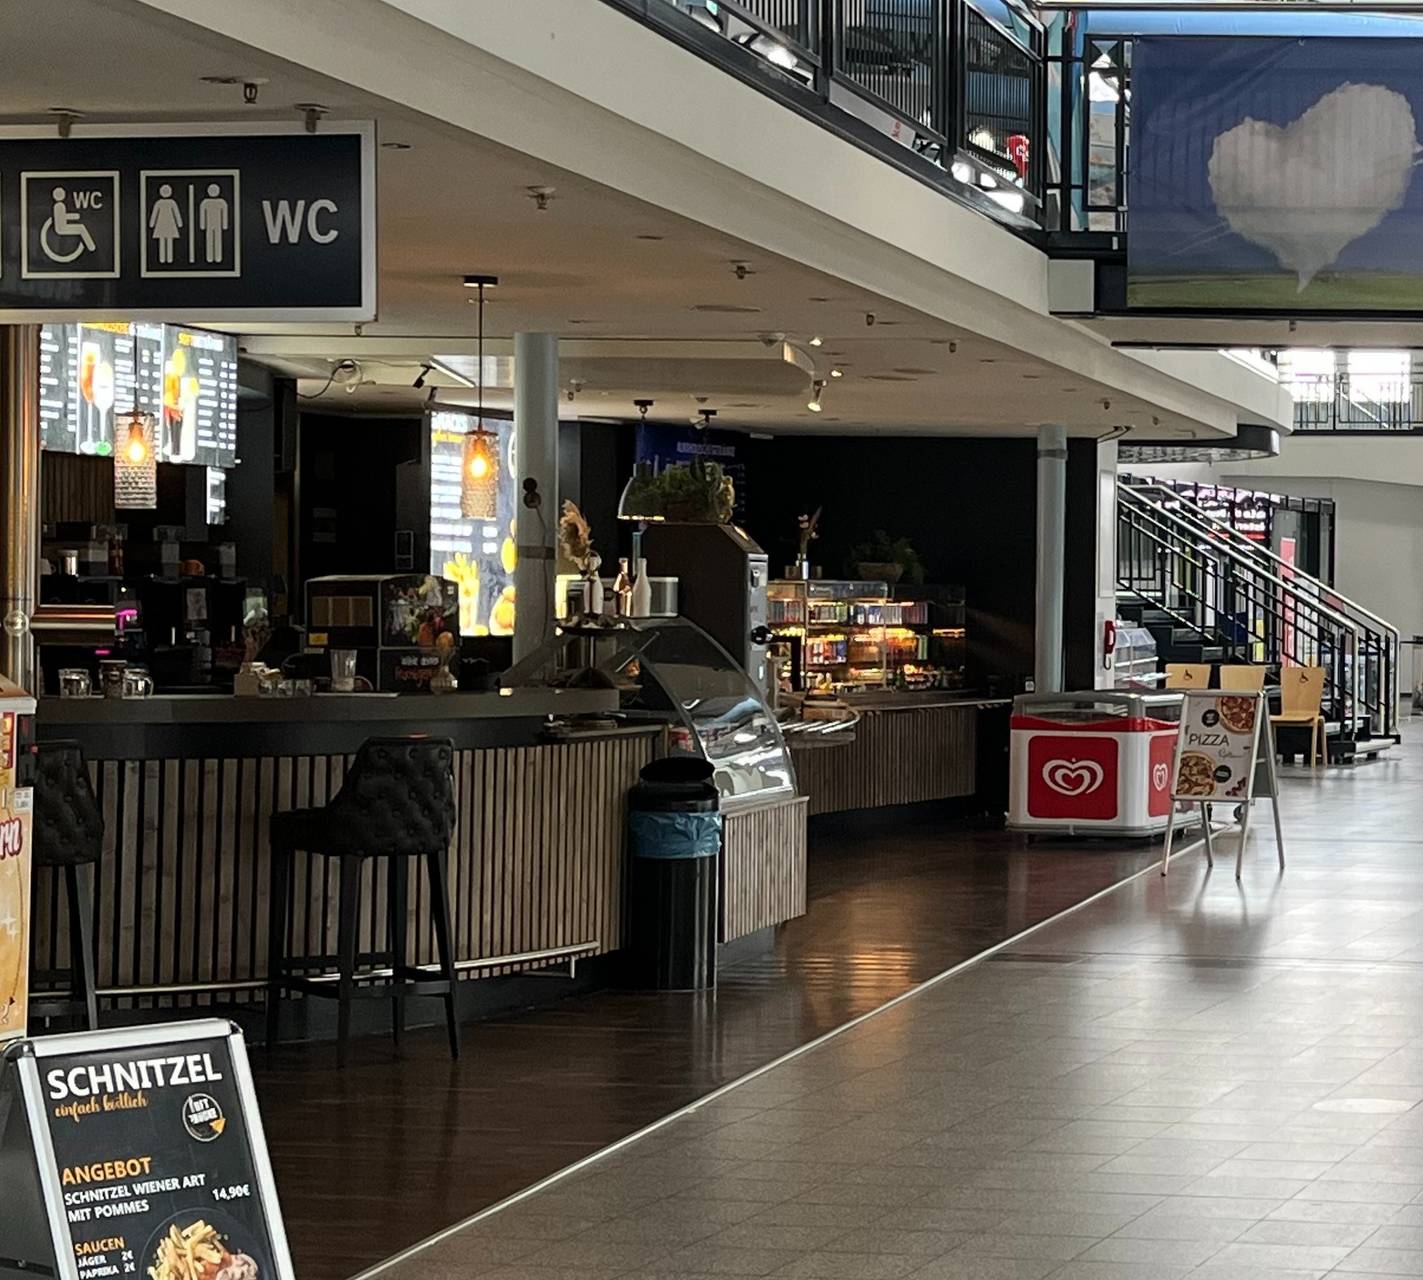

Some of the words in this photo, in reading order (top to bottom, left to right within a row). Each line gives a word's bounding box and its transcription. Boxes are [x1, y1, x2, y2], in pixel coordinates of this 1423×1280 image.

[73, 190, 103, 210] WC
[262, 198, 339, 245] WC
[1188, 733, 1230, 747] PIZZA
[47, 1053, 222, 1100] SCHNITZEL
[55, 1096, 100, 1123] einfach
[62, 1157, 152, 1186] ANGEBOT
[64, 1185, 132, 1206] SCHNITZEL
[133, 1178, 182, 1196] WIENER
[182, 1173, 206, 1189] ART
[212, 1184, 251, 1201] 14,90€
[68, 1208, 92, 1223] MIT
[95, 1199, 150, 1219] POMMES
[74, 1237, 125, 1256] SAUCEN
[78, 1254, 107, 1268] JÄGER
[121, 1250, 134, 1262] 2€
[79, 1265, 120, 1280] PAPRIKA
[124, 1262, 137, 1273] 2€
